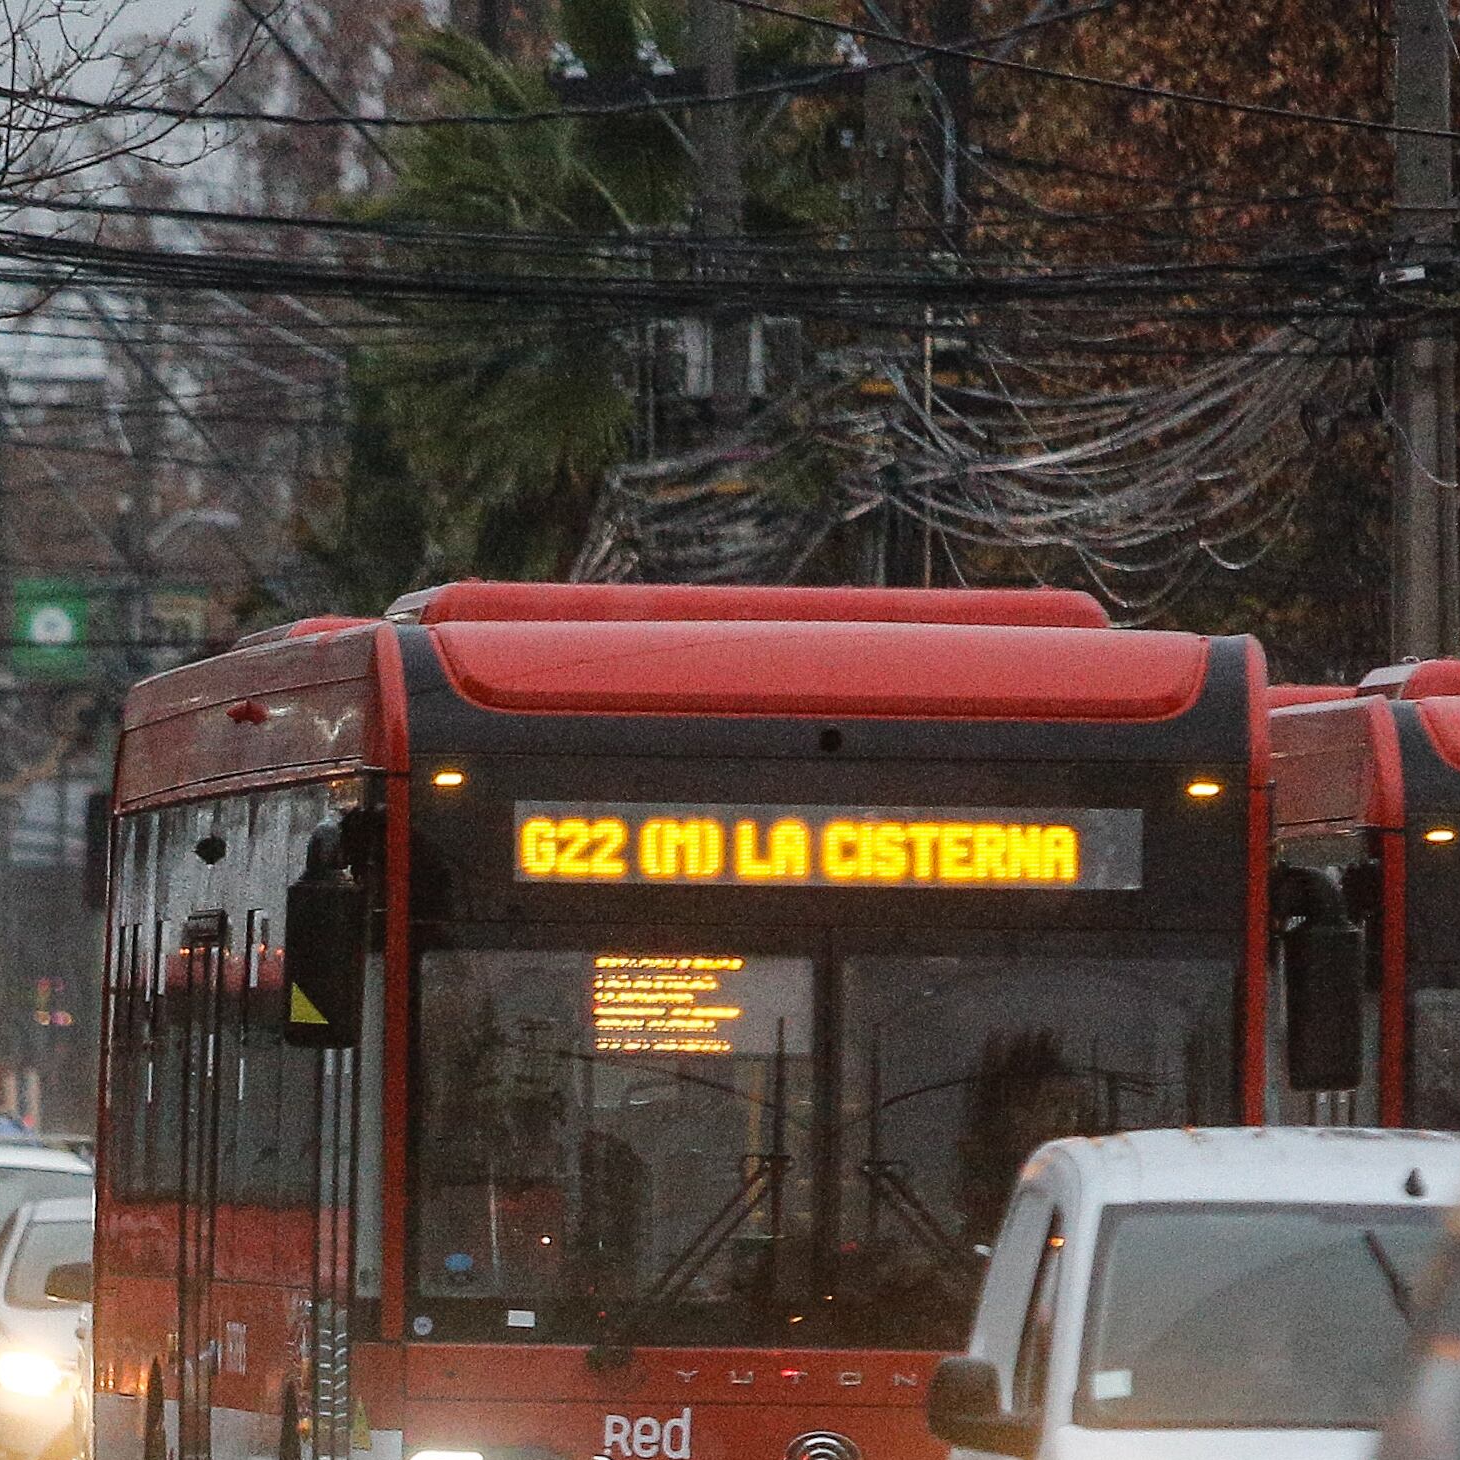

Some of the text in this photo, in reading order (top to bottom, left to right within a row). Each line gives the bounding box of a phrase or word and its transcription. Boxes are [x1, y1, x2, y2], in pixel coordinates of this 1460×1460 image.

[521, 819, 1079, 882] G22 (M) LA CISTERNA
[677, 1368, 919, 1387] YUTON
